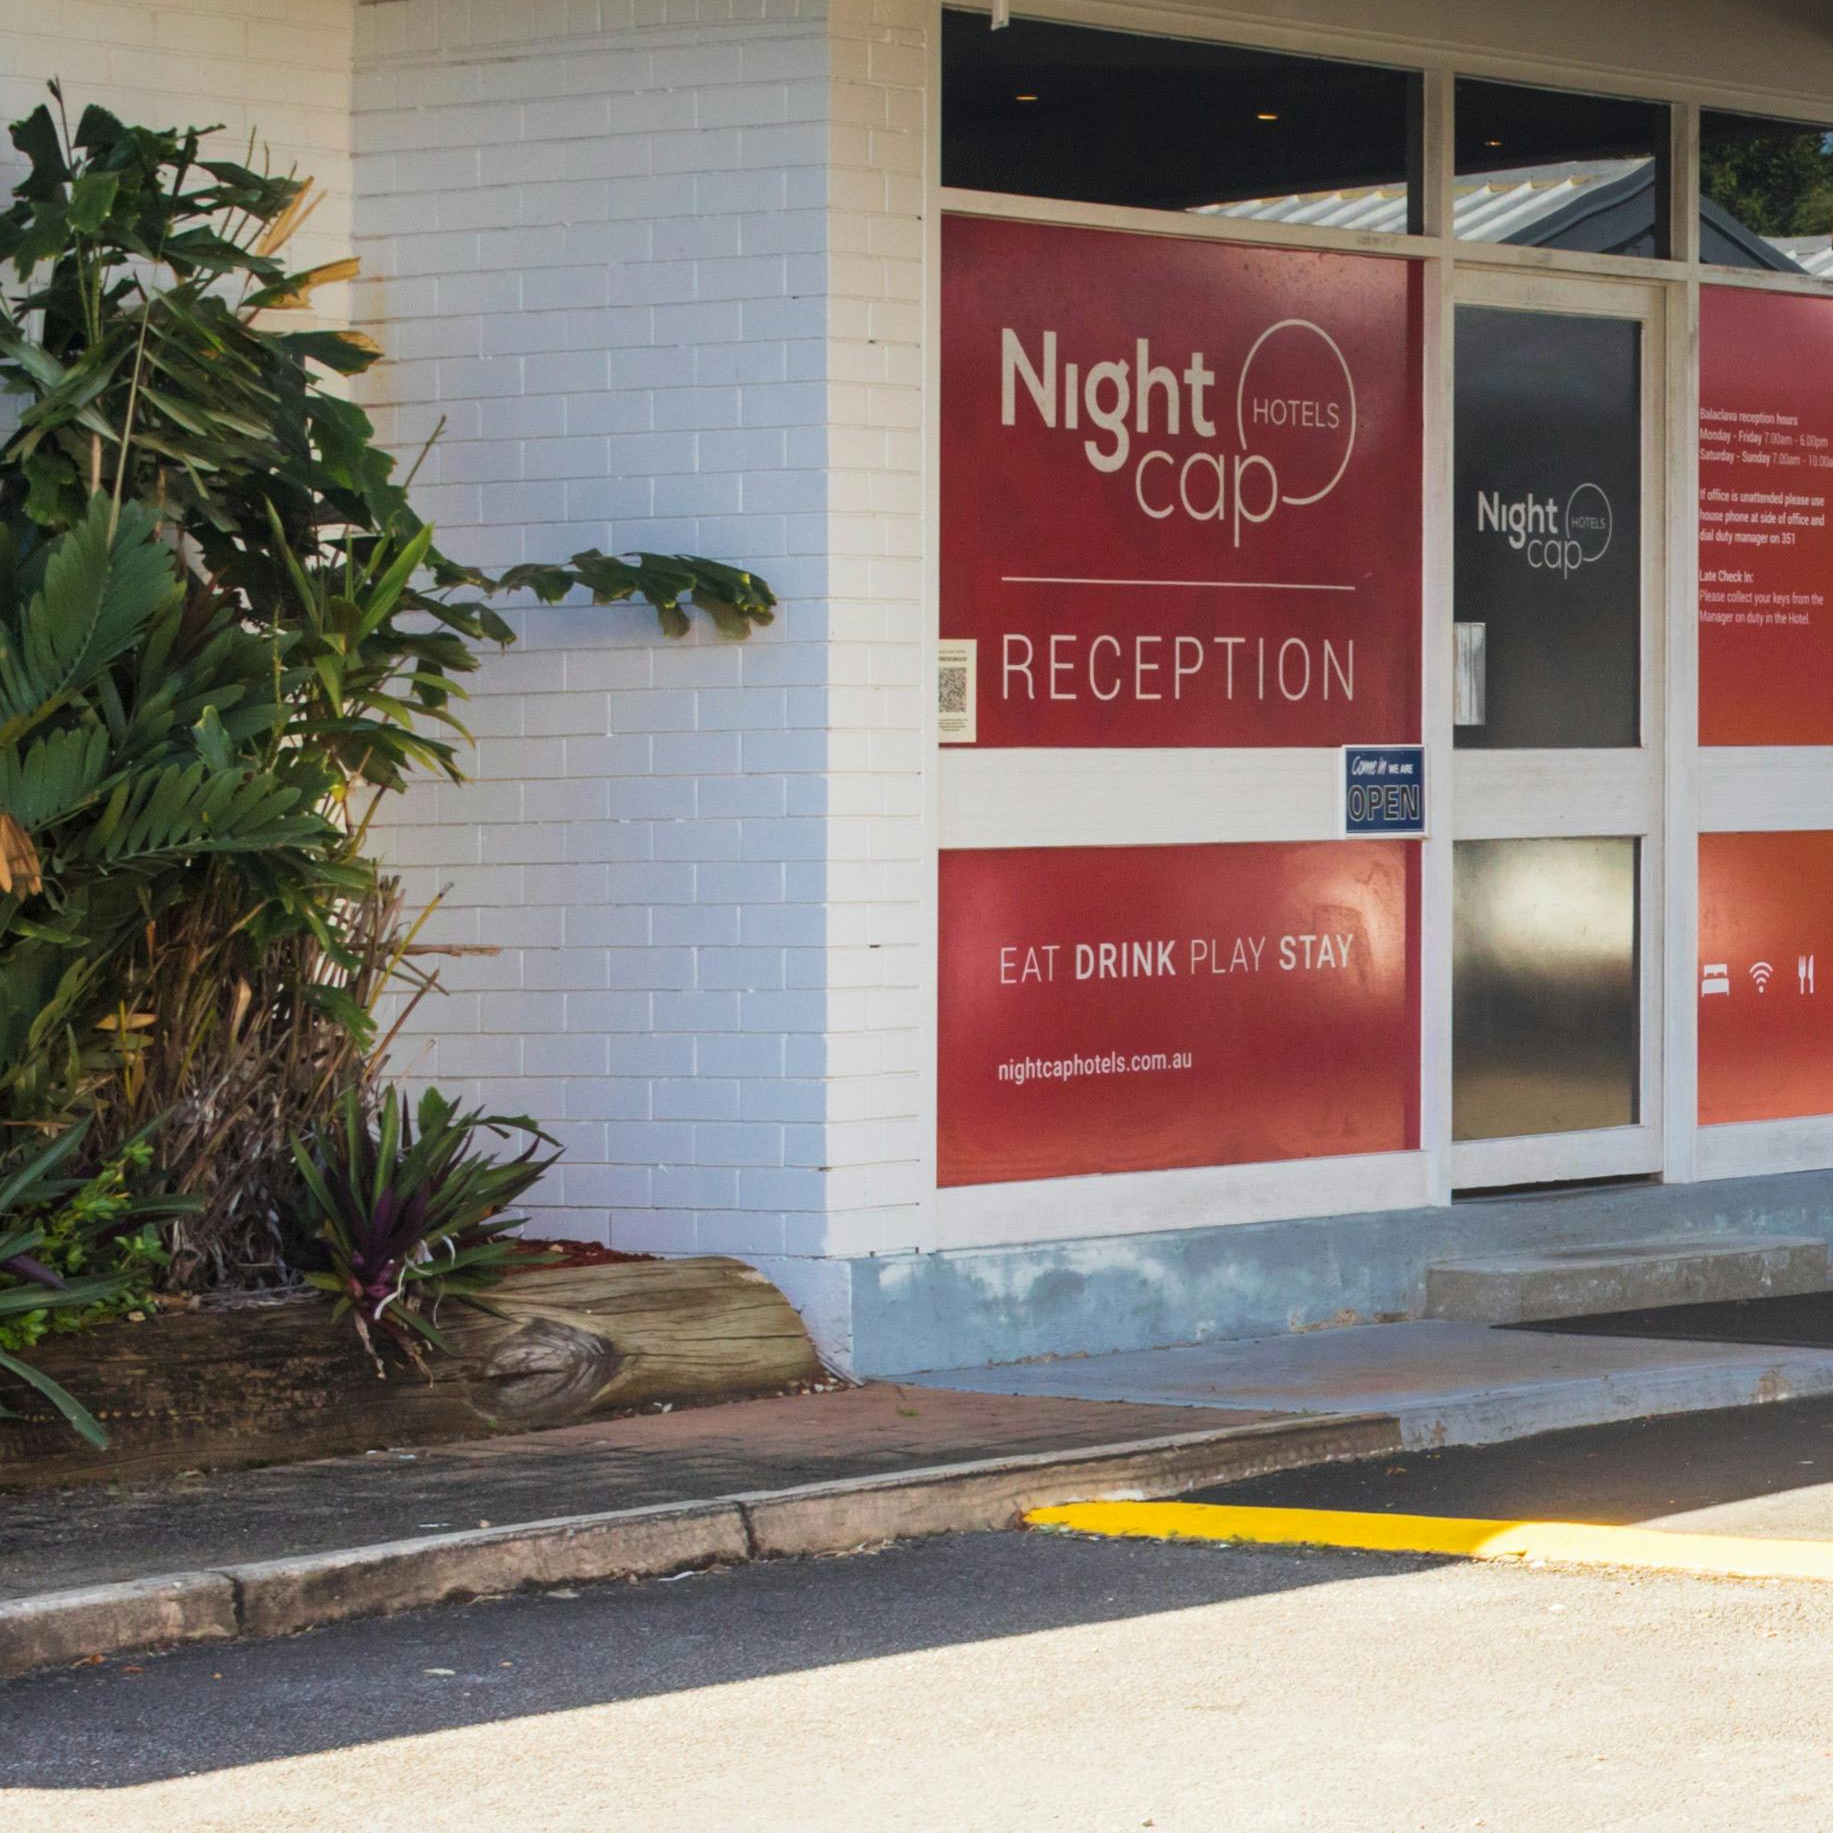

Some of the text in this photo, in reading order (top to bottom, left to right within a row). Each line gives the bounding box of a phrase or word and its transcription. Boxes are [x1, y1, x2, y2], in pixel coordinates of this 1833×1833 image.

[1001, 327, 1217, 473] Night
[1252, 398, 1341, 429] HOTELS
[1699, 407, 1799, 426] Balaclava reception hours
[1699, 427, 1732, 445] Monday
[1738, 429, 1763, 446] Friday
[1699, 447, 1736, 465] Saturday
[1741, 450, 1771, 467] Sunday
[1135, 450, 1278, 548] cap
[1706, 489, 1730, 502] office
[1731, 491, 1739, 503] is
[1740, 491, 1784, 505] unattended
[1784, 493, 1810, 507] please
[1810, 496, 1825, 507] use
[1477, 490, 1559, 550] Night
[1570, 516, 1607, 530] HOTELS
[1699, 508, 1825, 526] house phone at side of office and
[1699, 529, 1797, 546] dial duty manager on 351
[1527, 539, 1583, 580] cap
[1699, 570, 1718, 583] Late
[1718, 570, 1743, 583] Check
[1699, 590, 1825, 606] Please collect your keys from the
[1699, 610, 1734, 626] Manager
[1735, 613, 1746, 624] on
[1746, 612, 1764, 626] duty
[1765, 612, 1774, 624] in
[1774, 612, 1788, 624] the
[1002, 633, 1354, 702] RECEPTION
[1351, 756, 1378, 776] Come
[1388, 764, 1400, 775] WE
[1400, 764, 1414, 775] ARE
[1348, 784, 1420, 822] OPEN
[1001, 933, 1354, 984] EAT DRINK PLAY STAY
[998, 1050, 1193, 1085] nightcaphotels.com.au
